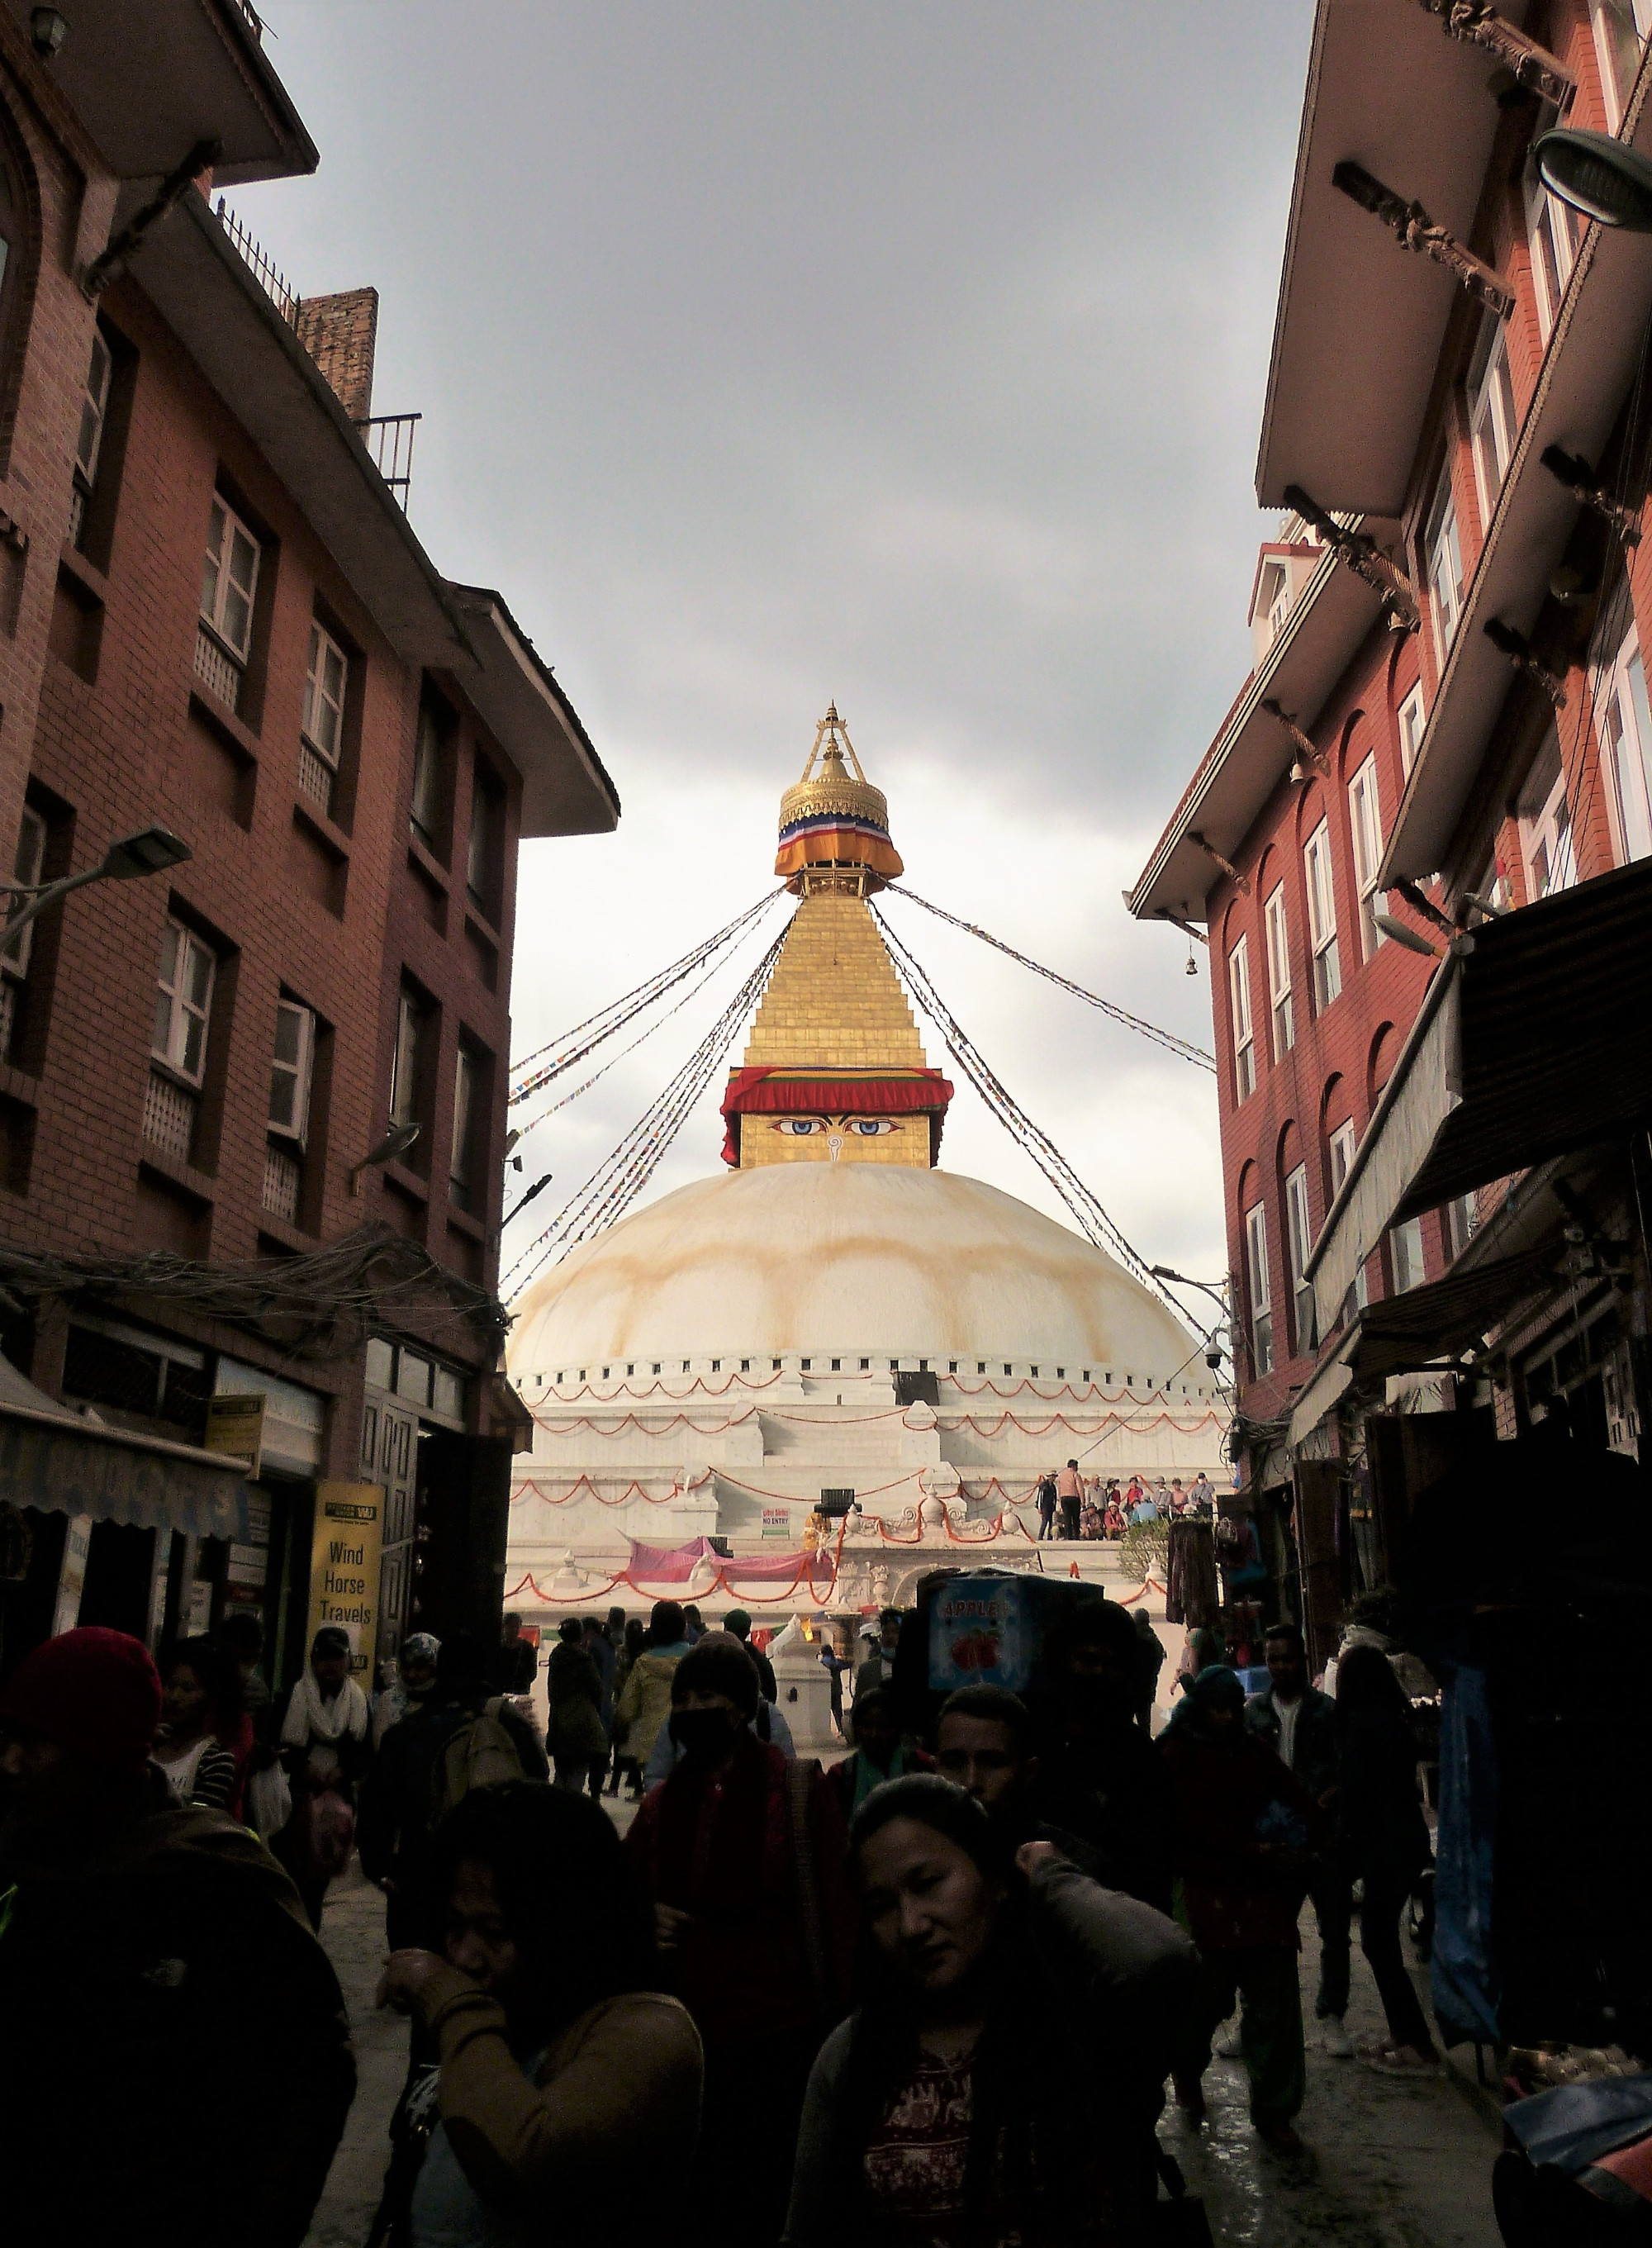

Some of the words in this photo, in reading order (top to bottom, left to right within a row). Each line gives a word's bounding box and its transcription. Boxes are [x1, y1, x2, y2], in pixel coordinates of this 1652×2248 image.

[330, 1542, 363, 1566] Wind
[325, 1571, 365, 1595] Horse
[320, 1600, 371, 1624] Travels
[944, 1600, 999, 1618] APPLE
